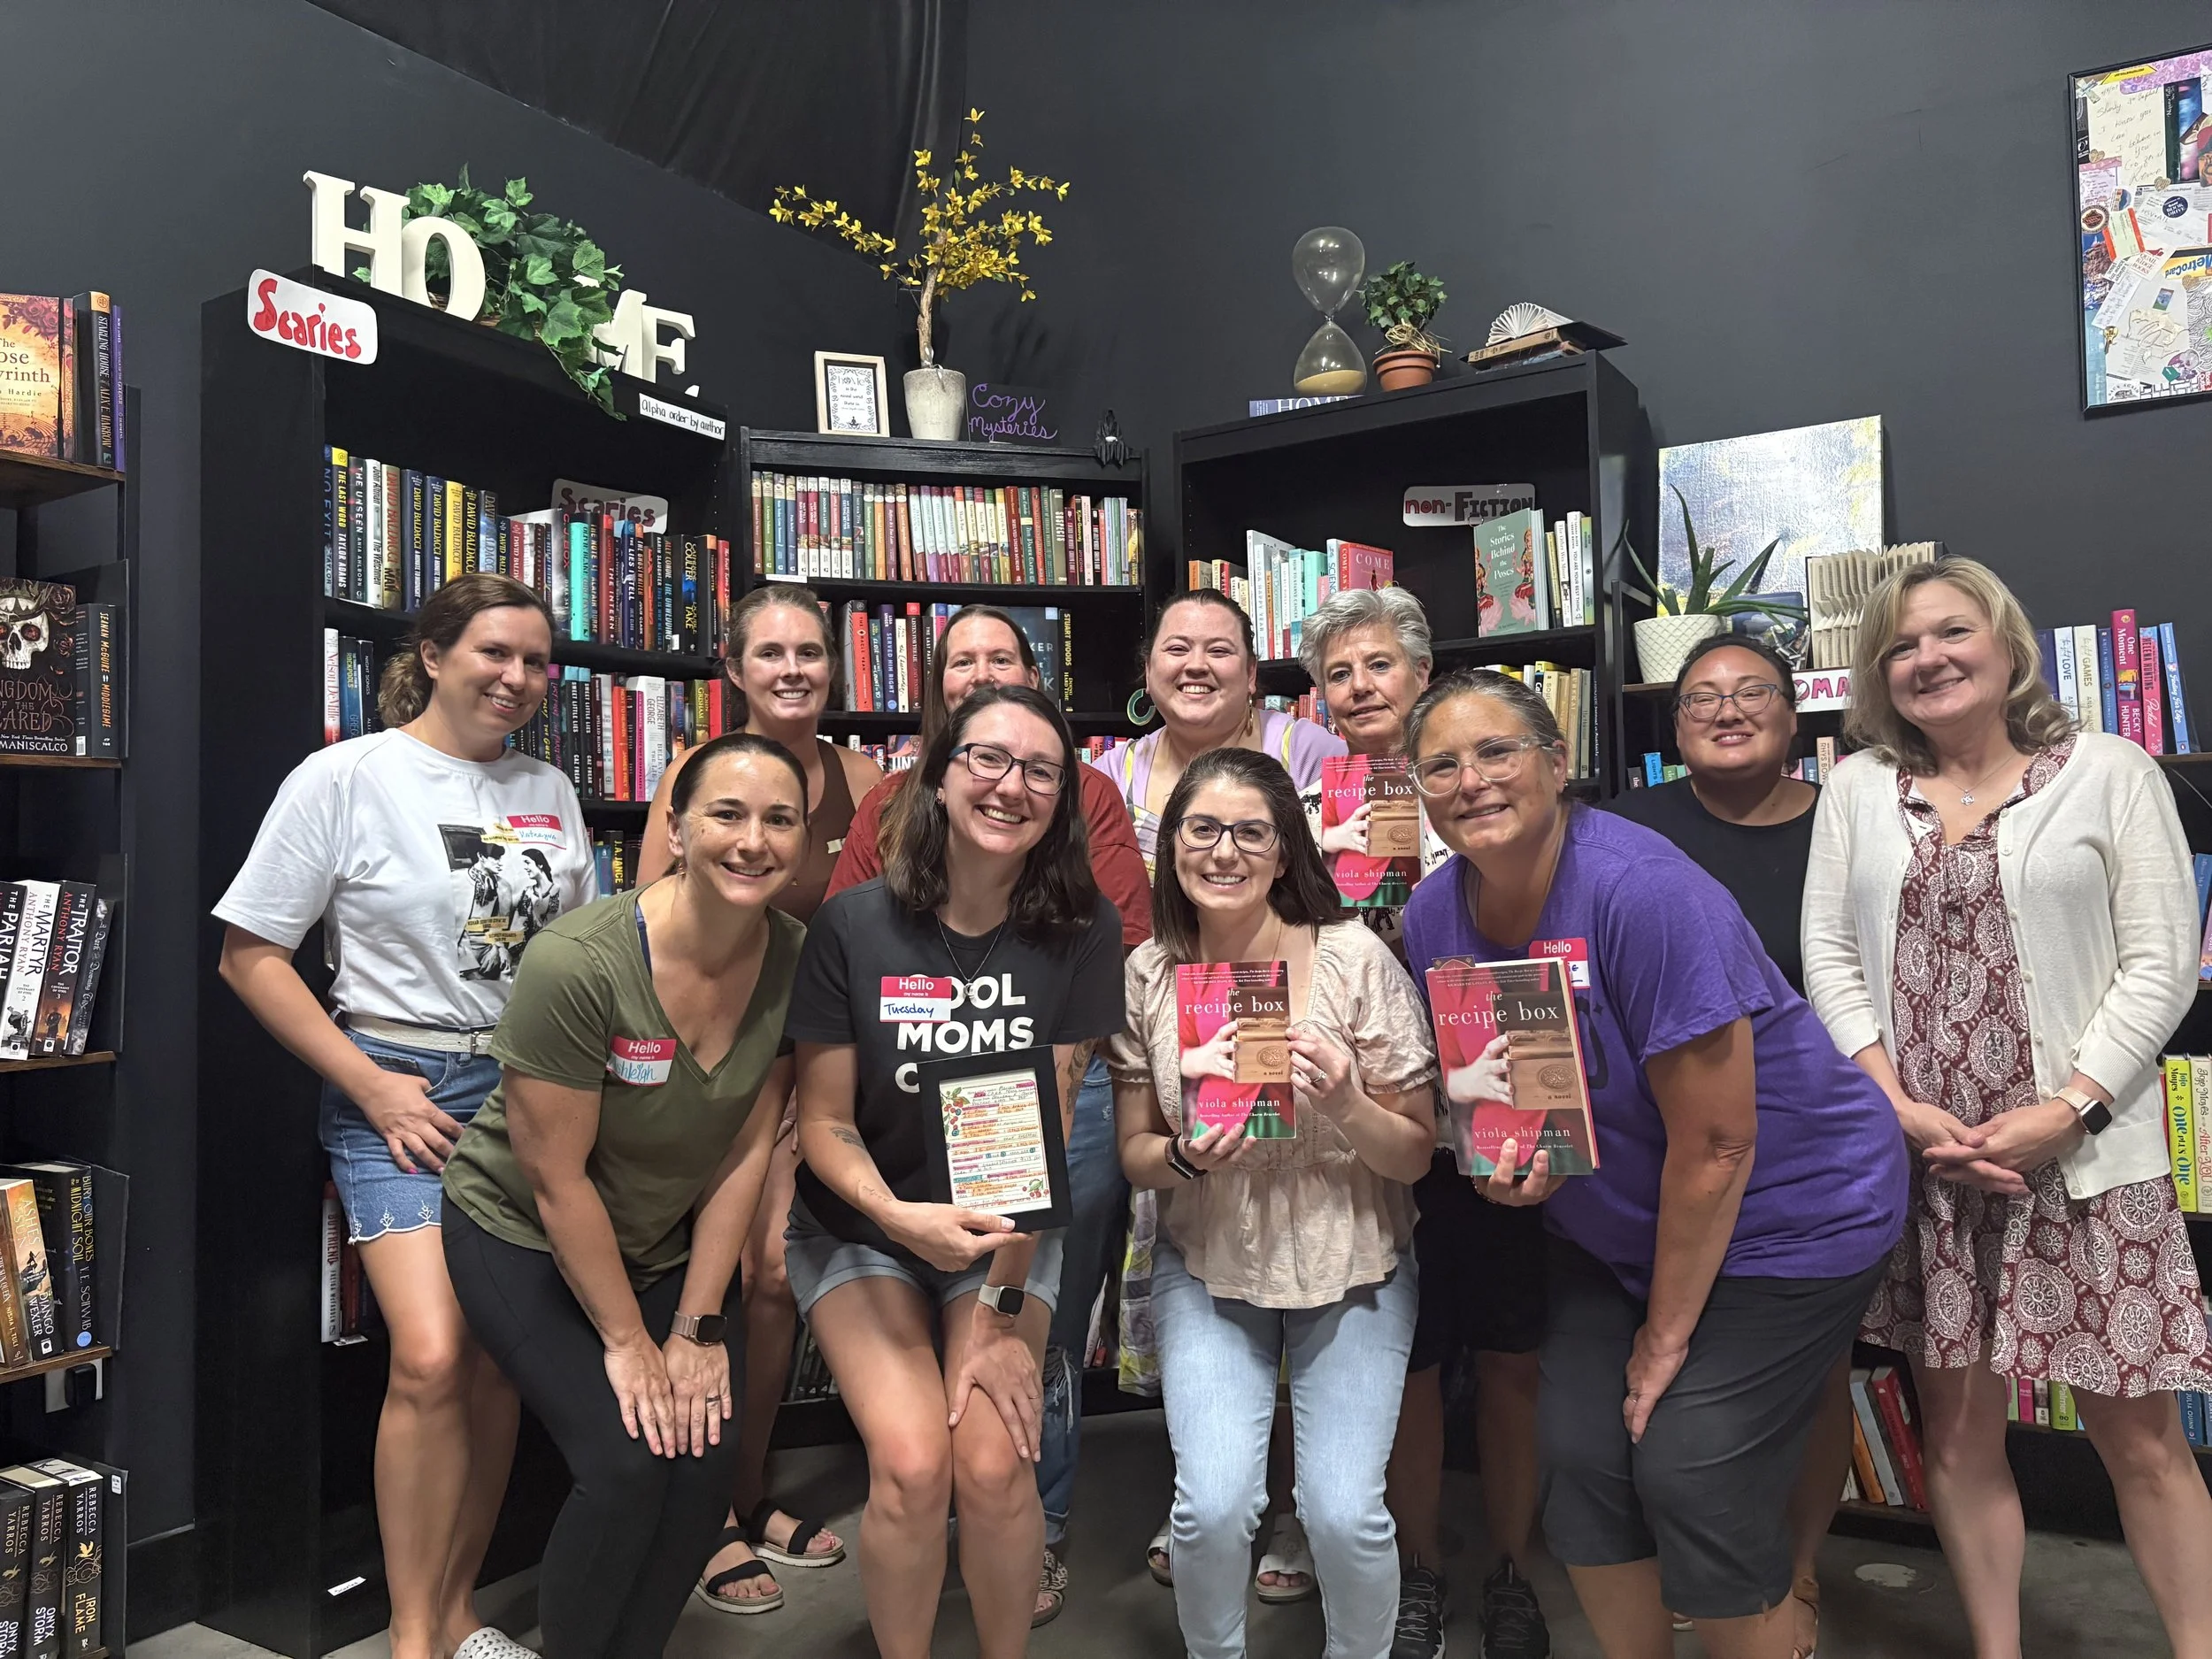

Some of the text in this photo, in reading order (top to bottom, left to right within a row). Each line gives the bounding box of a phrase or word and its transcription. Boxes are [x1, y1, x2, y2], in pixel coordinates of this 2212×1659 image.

[253, 278, 363, 359] Scaries
[8, 388, 42, 397] Hardie
[98, 316, 111, 448] STARLING HOUSE ALIX HARROW
[973, 383, 1046, 425] Cozy
[669, 410, 689, 426] order
[690, 415, 699, 431] by
[700, 419, 725, 435] author
[969, 416, 1058, 442] Mysteries
[373, 466, 381, 482] John
[338, 485, 347, 503] LAST
[355, 466, 364, 534] THE UNSEEN
[560, 488, 656, 527] Scaries
[387, 471, 398, 564] DAVID BALDACCI
[466, 502, 476, 529] DAVID
[1056, 511, 1065, 541] SUSPECTS
[1490, 533, 1515, 548] Stories
[1491, 543, 1516, 560] Behind
[1355, 553, 1390, 571] COME
[1494, 567, 1515, 580] Poses
[2116, 628, 2128, 665] Moment
[2126, 636, 2136, 655] One
[2062, 658, 2071, 680] LOVE
[2082, 657, 2093, 687] GAMES
[2142, 638, 2154, 690] HELENA HUNTING
[326, 652, 340, 722] Nelson DeMille
[2170, 674, 2178, 695] Finding
[102, 683, 111, 728] MIDDLEGAME
[647, 698, 656, 725] GEORGE
[656, 695, 665, 731] ELIZABETH
[2132, 708, 2141, 733] BECKY
[2121, 705, 2131, 737] HUNTER
[0, 741, 68, 752] MANISCALCO
[1328, 781, 1413, 800] recipe box
[521, 815, 550, 824] Hello
[614, 856, 624, 884] JANCE
[1336, 869, 1407, 879] viola shipman
[9, 890, 19, 910] THE
[17, 892, 38, 973] ANTHONY RYAN
[25, 910, 53, 976] MARTYR
[51, 892, 74, 972] ANTHONY RYAN
[59, 893, 88, 976] THE TRAITOR
[1543, 942, 1571, 954] Hello
[899, 979, 934, 991] Hello
[1227, 987, 1240, 996] the
[1486, 991, 1502, 1002] the
[884, 1002, 934, 1018] Tuesday
[1185, 996, 1284, 1018] recipe box
[1438, 1001, 1559, 1029] recipe box
[628, 1041, 661, 1054] Hello
[896, 1017, 1034, 1054] MOMS
[2170, 1067, 2179, 1091] Moyes
[2179, 1072, 2188, 1087] Jojo
[1199, 1098, 1280, 1110] viola shipman
[1474, 1127, 1571, 1139] viola shipman
[2194, 1067, 2212, 1183] Jojo Moyes After YOU
[2171, 1105, 2193, 1186] One One
[14, 1217, 25, 1248] SUN
[22, 1199, 41, 1245] ASHES
[70, 1187, 84, 1264] MIDNIGHT SOIL
[81, 1175, 95, 1331] BURY OUR BONES SCHWAB
[327, 1214, 339, 1265] BOYFRIEND
[29, 1298, 43, 1337] WEXLER
[39, 1291, 55, 1335] DJANGO
[2057, 1385, 2069, 1416] Palmer
[40, 1500, 51, 1541] YARROS
[53, 1494, 64, 1543] REBECCA
[88, 1486, 97, 1534] REBECCA
[4, 1512, 16, 1554] YARROS
[18, 1505, 30, 1555] REBECCA
[44, 1607, 57, 1640] ONYX
[74, 1593, 86, 1634] FLAME
[86, 1596, 96, 1624] IRON
[5, 1621, 19, 1654] ONYX
[34, 1607, 47, 1647] STORM
